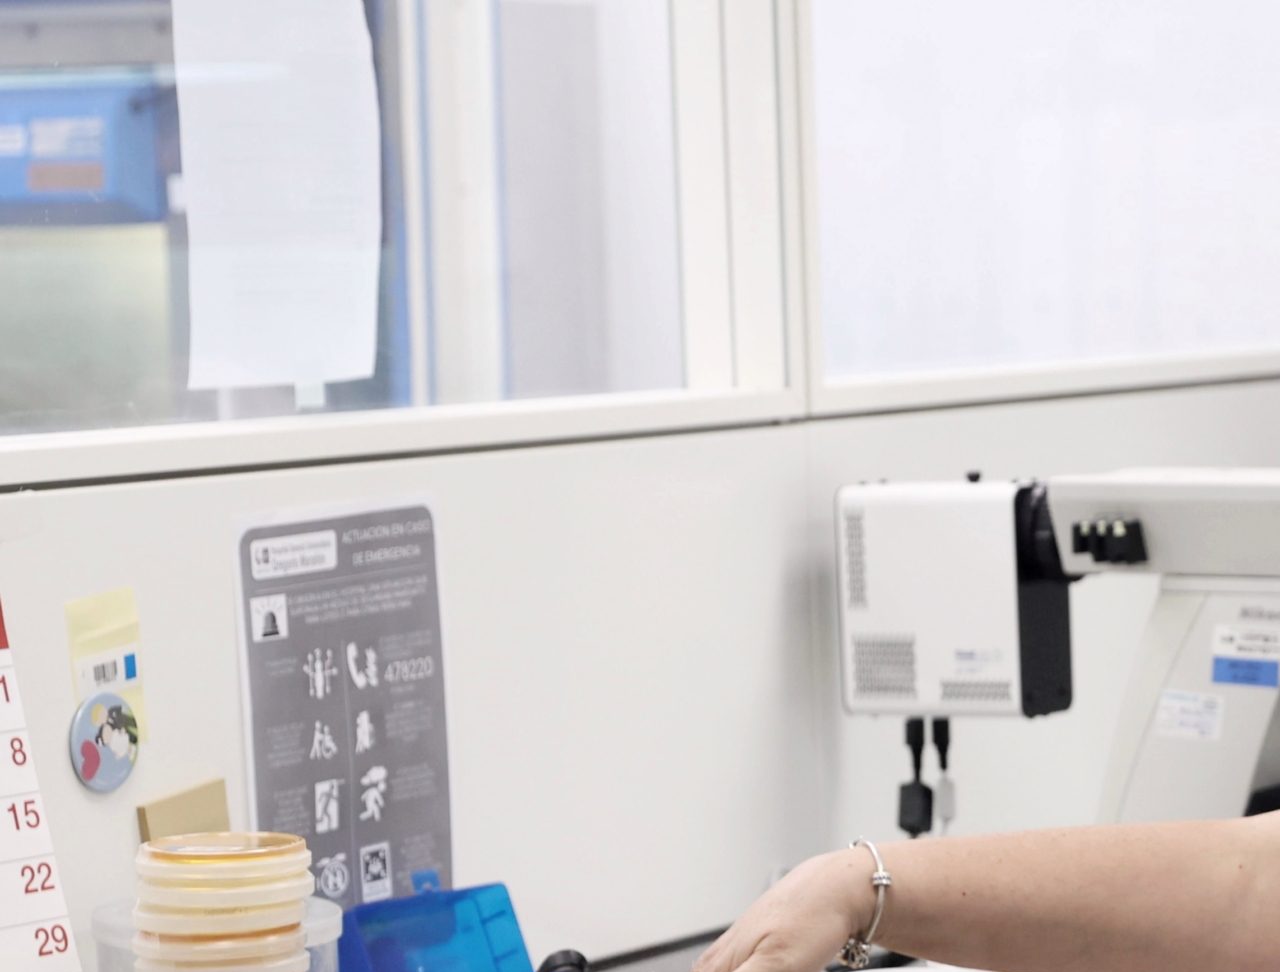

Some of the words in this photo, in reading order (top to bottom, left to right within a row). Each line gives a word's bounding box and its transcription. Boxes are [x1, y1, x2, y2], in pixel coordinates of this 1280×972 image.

[10, 737, 27, 767] 8
[7, 799, 41, 831] 15
[20, 862, 55, 895] 22
[34, 924, 69, 957] 29
